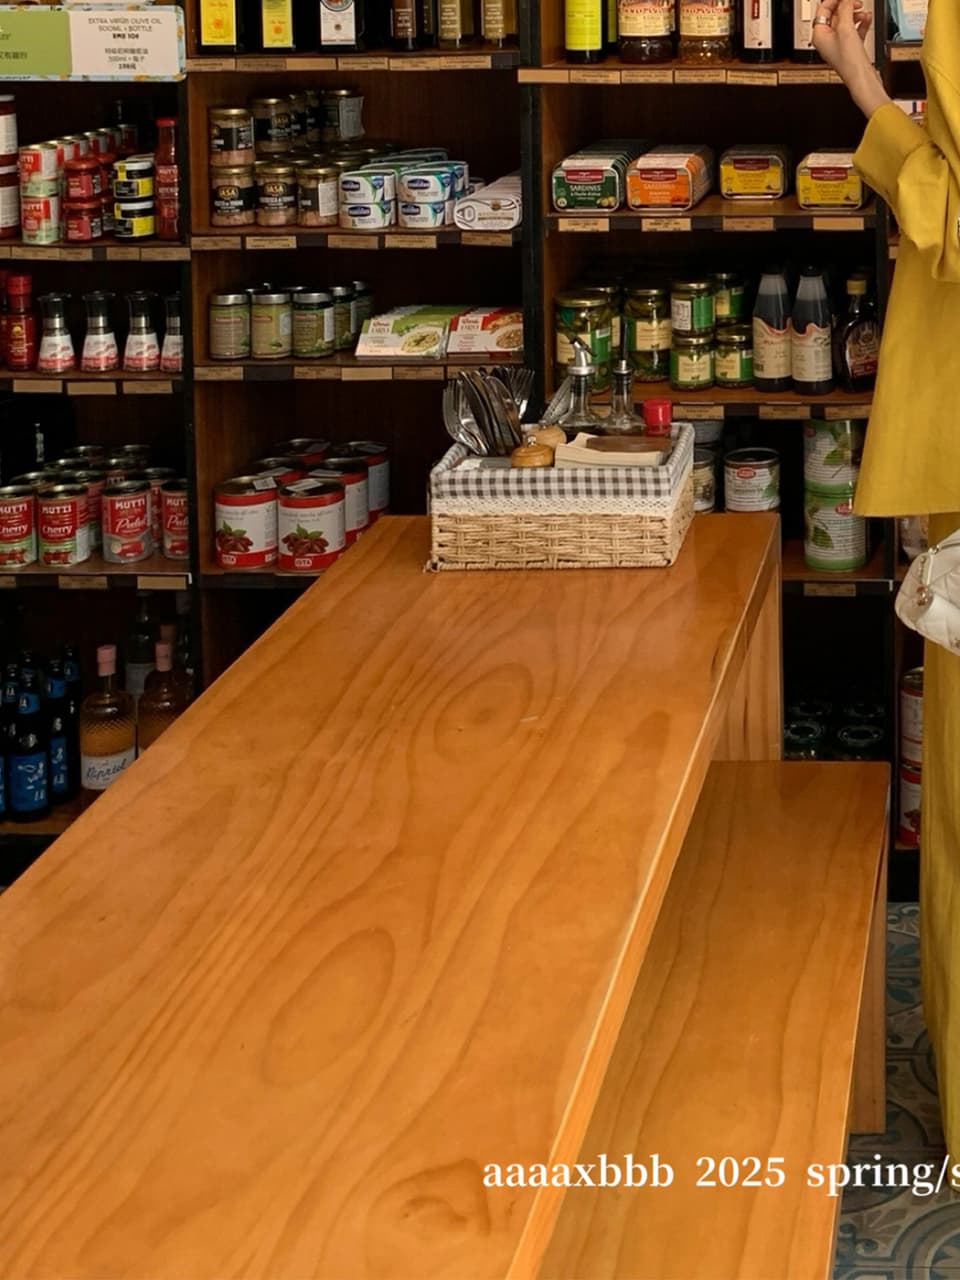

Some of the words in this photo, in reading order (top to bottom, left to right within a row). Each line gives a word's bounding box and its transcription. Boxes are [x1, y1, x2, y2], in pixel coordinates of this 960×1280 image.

[88, 17, 108, 25] EXTRA
[131, 17, 149, 25] OLIVE
[115, 498, 145, 510] MUTTI
[166, 496, 187, 506] MUT
[42, 504, 72, 513] MUTTI
